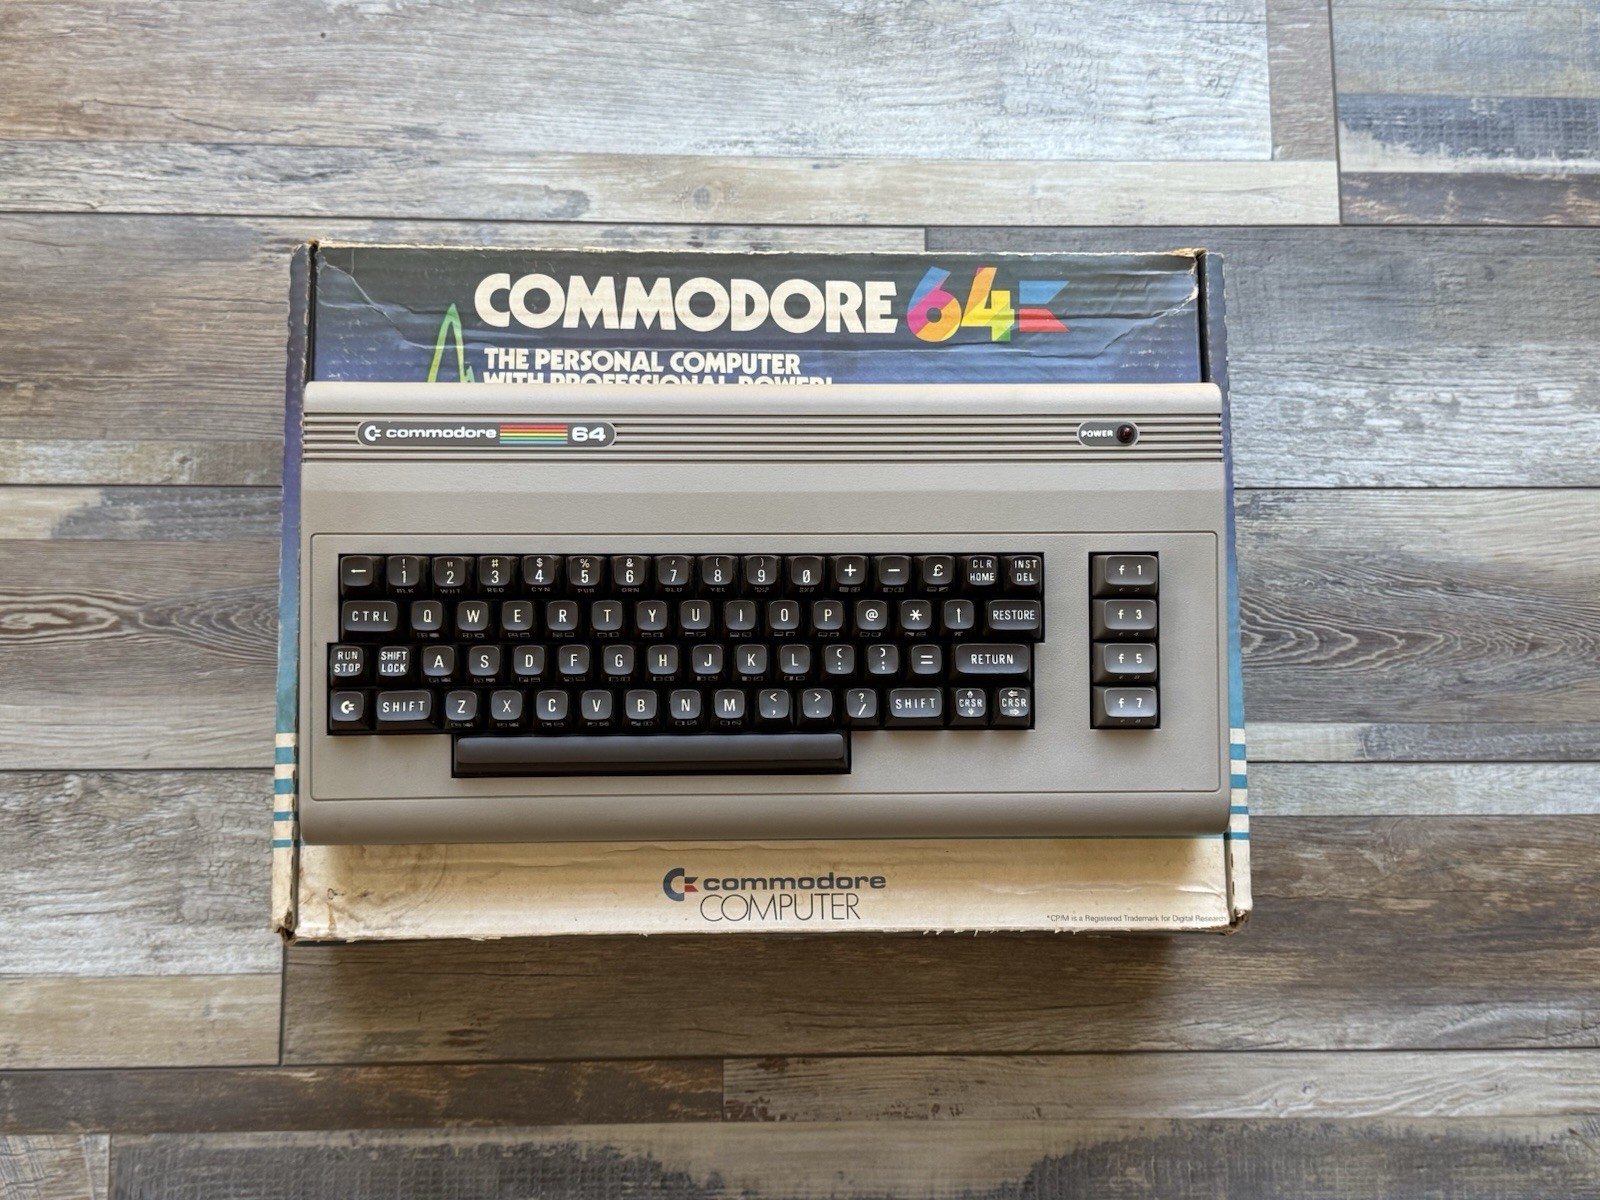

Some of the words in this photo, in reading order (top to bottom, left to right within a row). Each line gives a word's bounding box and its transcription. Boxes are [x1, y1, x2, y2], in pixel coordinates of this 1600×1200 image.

[474, 273, 898, 334] COMMODORE
[907, 266, 1015, 343] 64
[484, 347, 529, 370] THE
[535, 348, 664, 372] PERSONAL
[670, 351, 802, 375] COMPUTER
[386, 426, 497, 439] commodore
[571, 427, 606, 442] 64
[1081, 429, 1114, 438] POWER
[491, 558, 499, 568] #
[536, 557, 543, 568] $
[579, 558, 591, 569] %
[625, 558, 634, 568] &
[972, 559, 993, 569] CLR
[1014, 559, 1038, 569] INST
[401, 570, 407, 584] 1
[446, 570, 454, 584] 2
[491, 570, 499, 584] 3
[535, 569, 544, 583] 4
[581, 569, 589, 584] 5
[625, 569, 634, 584] 6
[670, 569, 677, 583] 7
[713, 569, 722, 583] 8
[757, 569, 766, 583] 9
[844, 563, 857, 577] +
[932, 563, 943, 577] £
[969, 572, 995, 582] HOME
[1016, 572, 1035, 582] DEL
[351, 610, 389, 622] CTRL
[423, 609, 432, 623] Q
[466, 609, 480, 623] W
[514, 609, 521, 623] E
[558, 609, 567, 623] R
[603, 609, 612, 623] T
[648, 609, 657, 623] Y
[691, 608, 700, 622] U
[780, 608, 789, 622] O
[824, 608, 833, 622] P
[865, 608, 879, 622] @
[992, 609, 1036, 621] RESTORE
[337, 651, 358, 660] RUN
[380, 651, 408, 661] SHIFT
[433, 654, 444, 669] A
[480, 654, 489, 669] S
[525, 654, 534, 668] D
[570, 653, 578, 667] F
[614, 654, 624, 668] G
[658, 654, 668, 667] H
[703, 653, 712, 667] J
[747, 653, 756, 667] K
[791, 653, 799, 667] L
[920, 655, 934, 665] =
[970, 653, 1014, 665] RETURN
[333, 663, 361, 673] STOP
[381, 663, 406, 673] LOCK
[769, 692, 778, 702] <
[814, 692, 822, 702] >
[858, 692, 865, 703] ?
[895, 698, 935, 710] SHIFT
[958, 698, 983, 708] CRSR
[1001, 698, 1027, 708] CRSR
[382, 700, 424, 713] SHIFT
[457, 699, 466, 714] Z
[502, 699, 512, 713] X
[548, 698, 557, 713] C
[592, 699, 601, 713] V
[637, 698, 646, 713] B
[681, 698, 691, 712] N
[723, 698, 736, 712] M
[857, 703, 867, 716] /
[703, 871, 886, 891] commodore
[699, 892, 861, 921] COMPUTER
[1085, 915, 1122, 923] Registered
[1172, 915, 1194, 923] Digital
